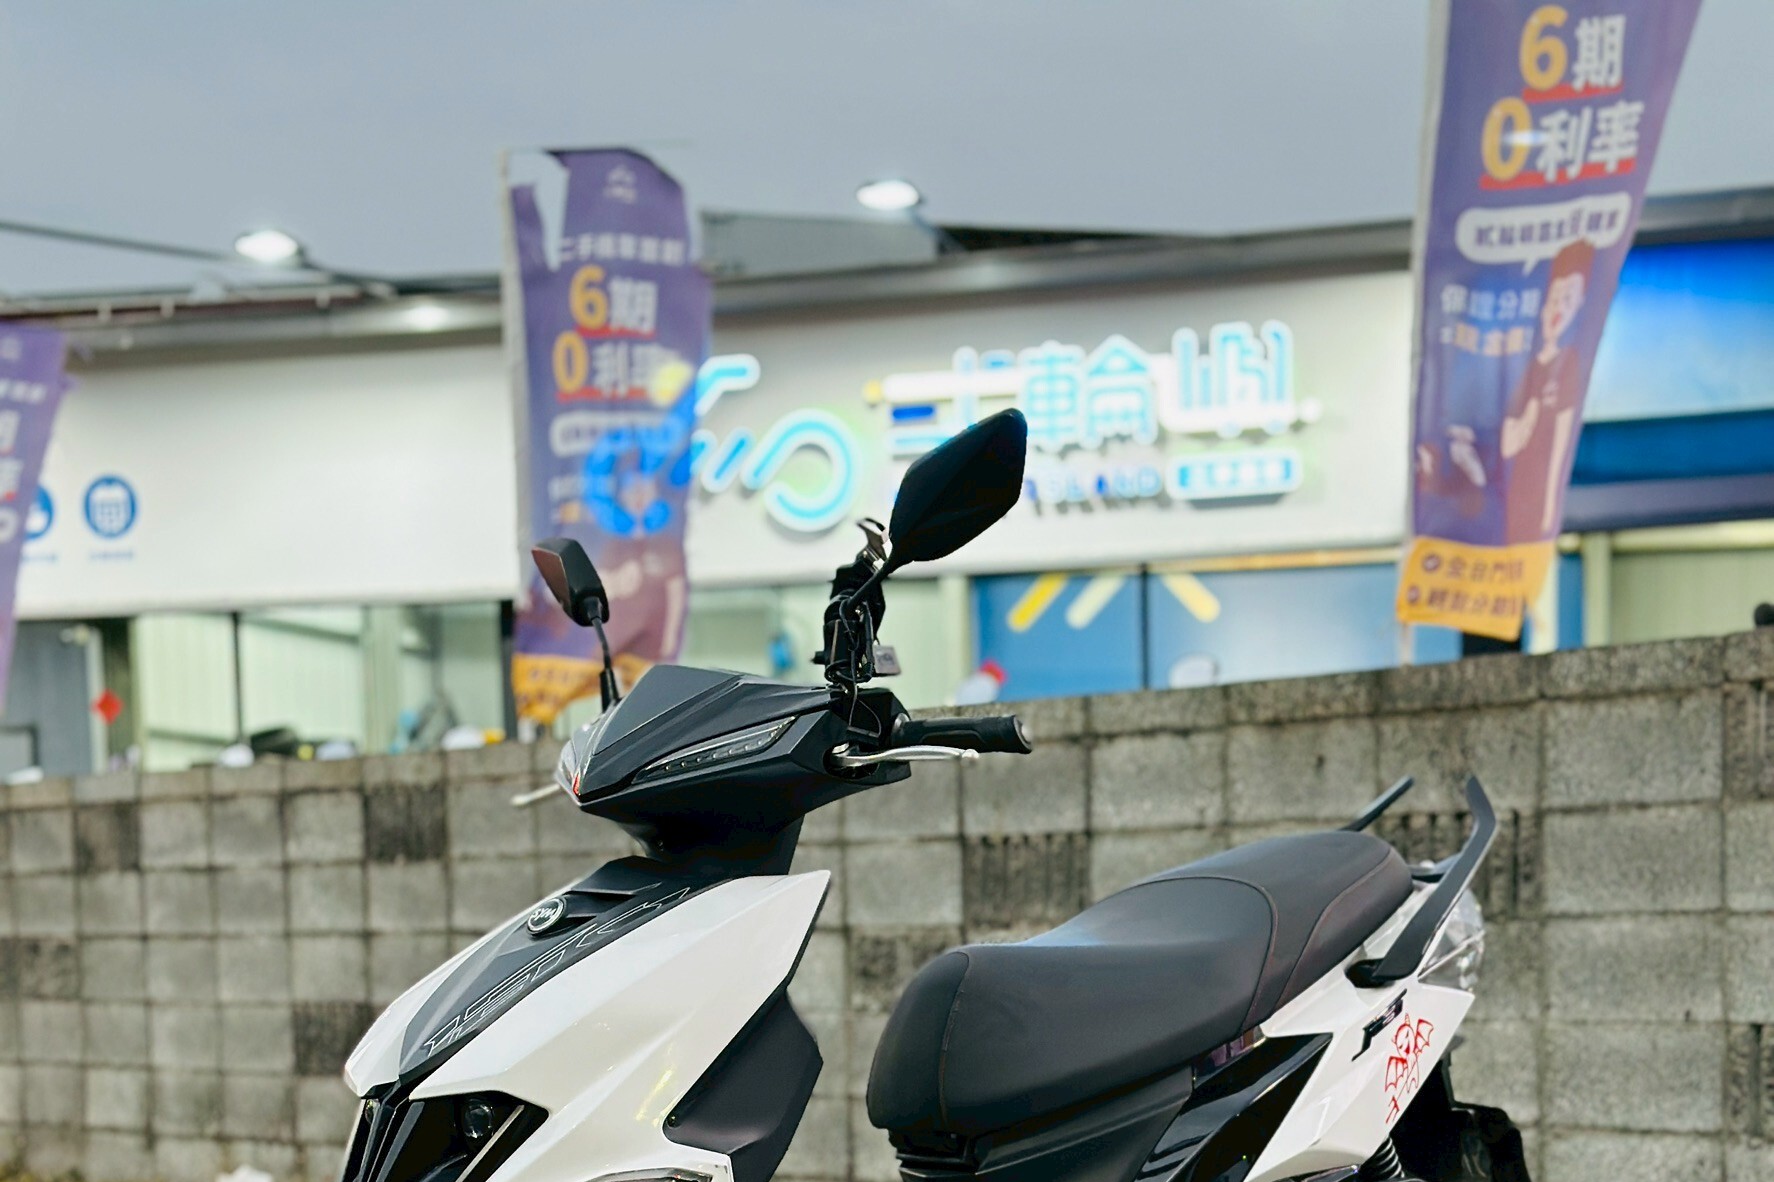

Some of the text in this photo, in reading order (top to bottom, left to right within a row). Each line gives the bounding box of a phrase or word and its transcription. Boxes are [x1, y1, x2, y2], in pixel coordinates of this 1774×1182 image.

[1519, 5, 1626, 91] 6期
[1481, 97, 1645, 182] 0利率
[532, 906, 557, 922] SYM
